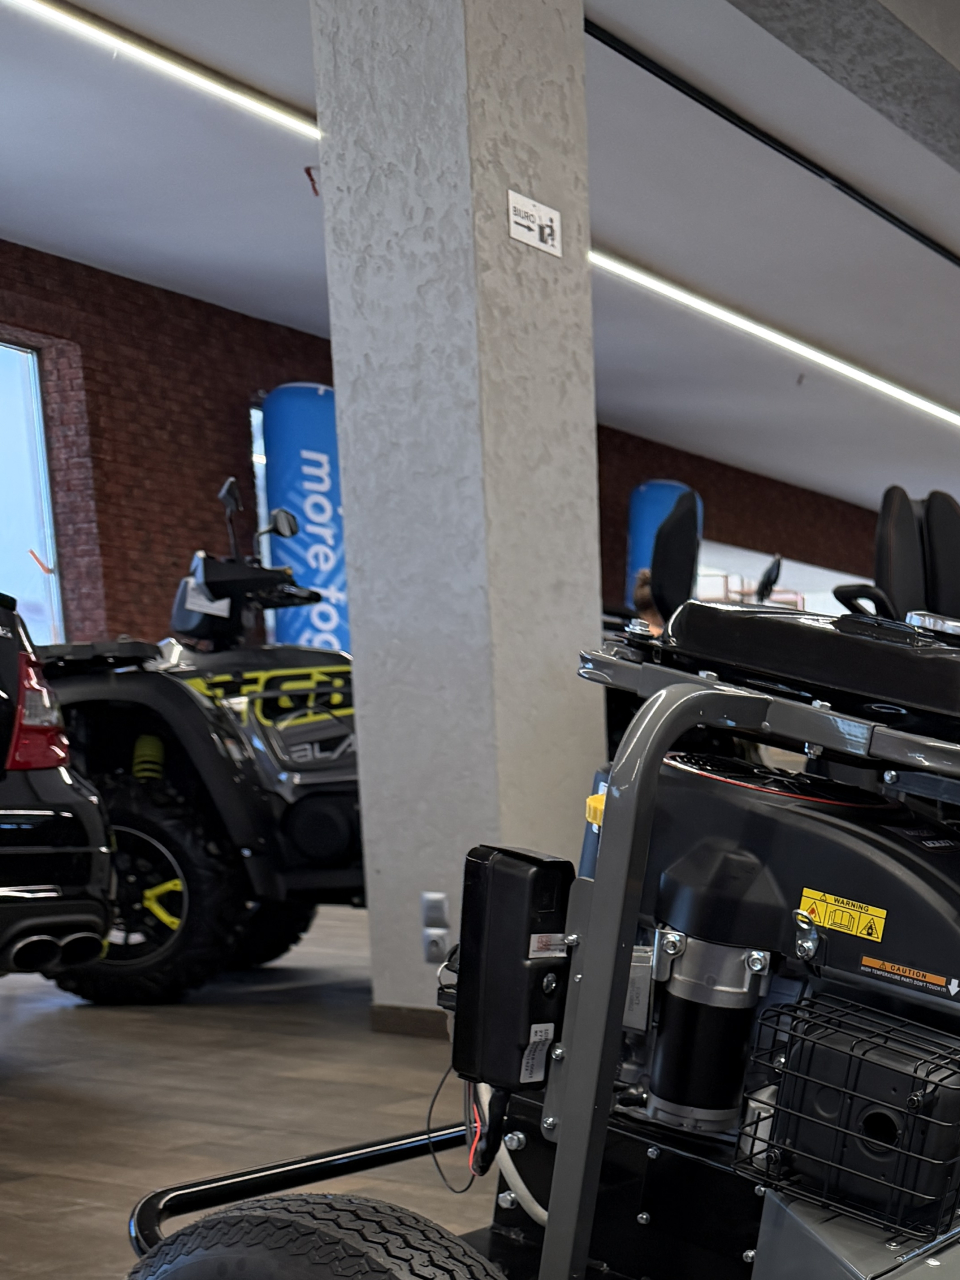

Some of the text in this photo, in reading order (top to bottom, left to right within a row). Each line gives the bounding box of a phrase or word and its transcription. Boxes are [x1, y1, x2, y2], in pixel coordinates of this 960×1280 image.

[300, 449, 336, 572] more
[834, 897, 869, 912] WARNING
[871, 969, 901, 981] TEMPERATURE
[926, 983, 941, 991] TOUCH
[890, 964, 927, 980] CAUTION
